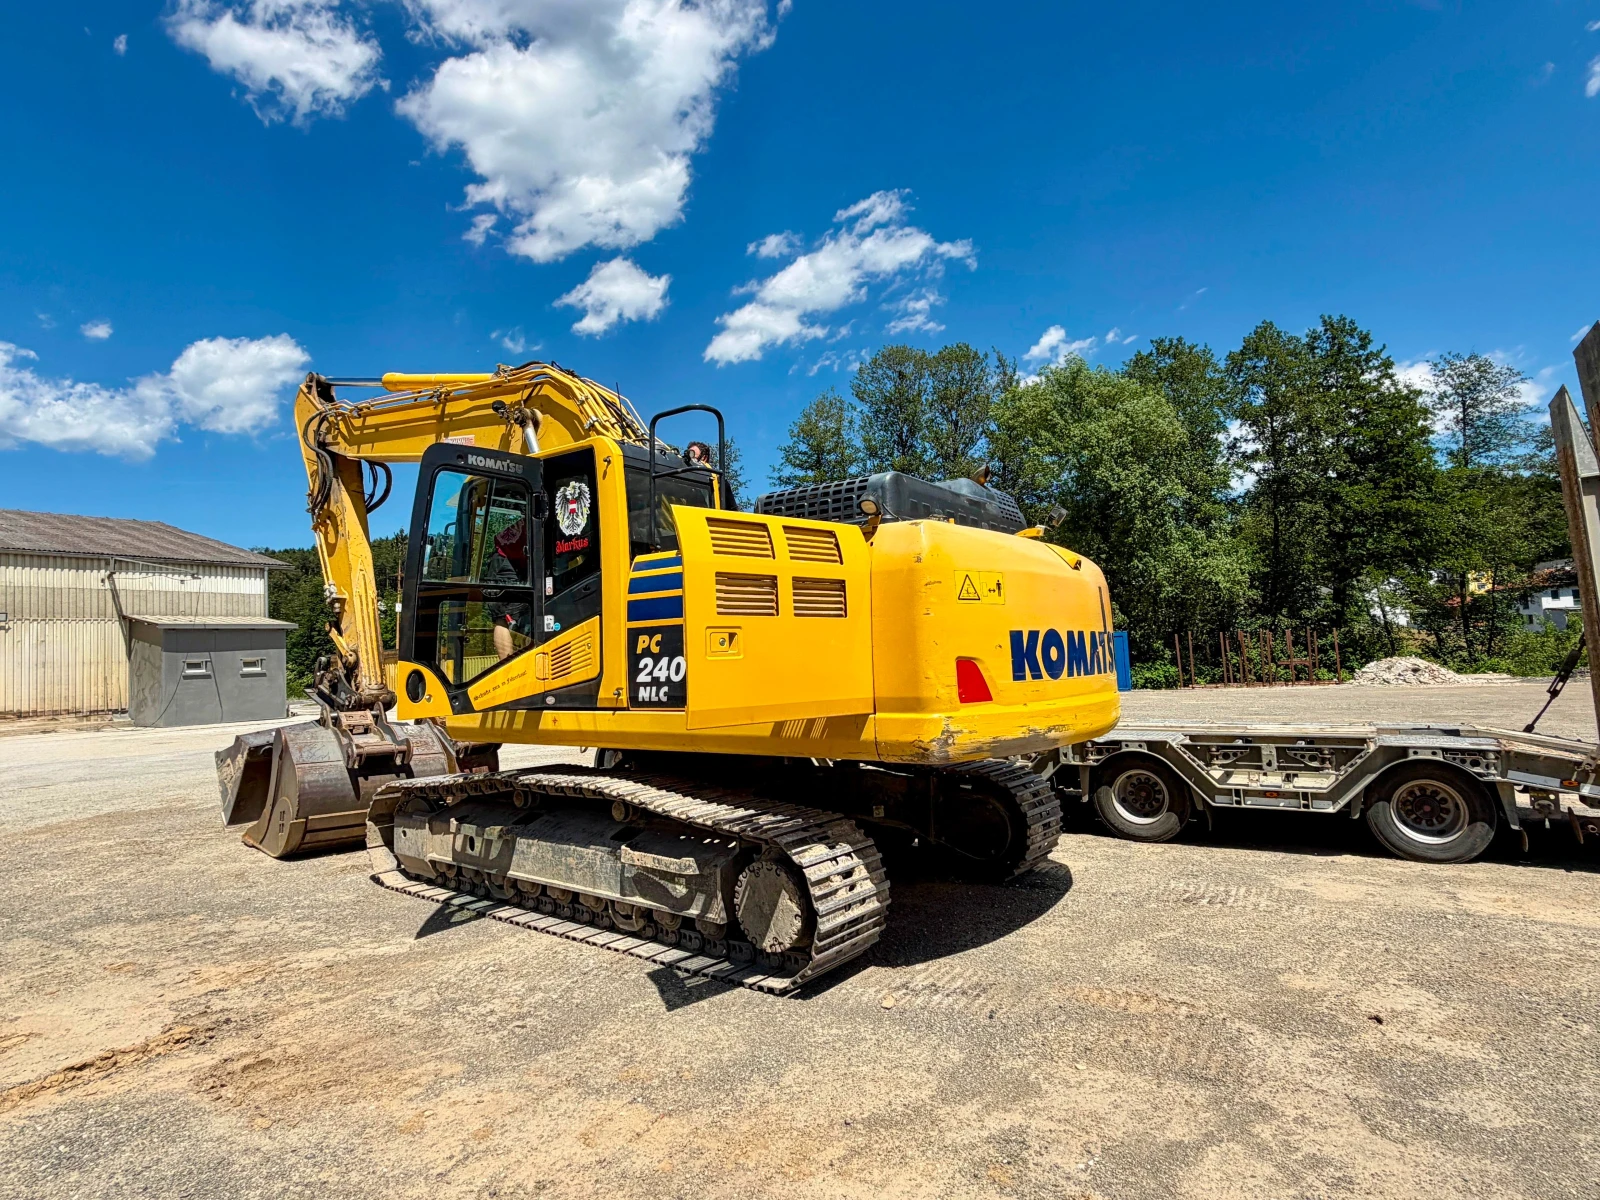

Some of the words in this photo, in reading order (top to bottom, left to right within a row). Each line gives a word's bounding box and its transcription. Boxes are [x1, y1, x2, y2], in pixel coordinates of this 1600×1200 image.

[467, 453, 524, 474] KOMATSU
[556, 537, 589, 555] Markus
[636, 633, 662, 654] PC
[1009, 628, 1115, 682] KOMATS
[635, 655, 687, 683] 240
[638, 685, 669, 702] NLC
